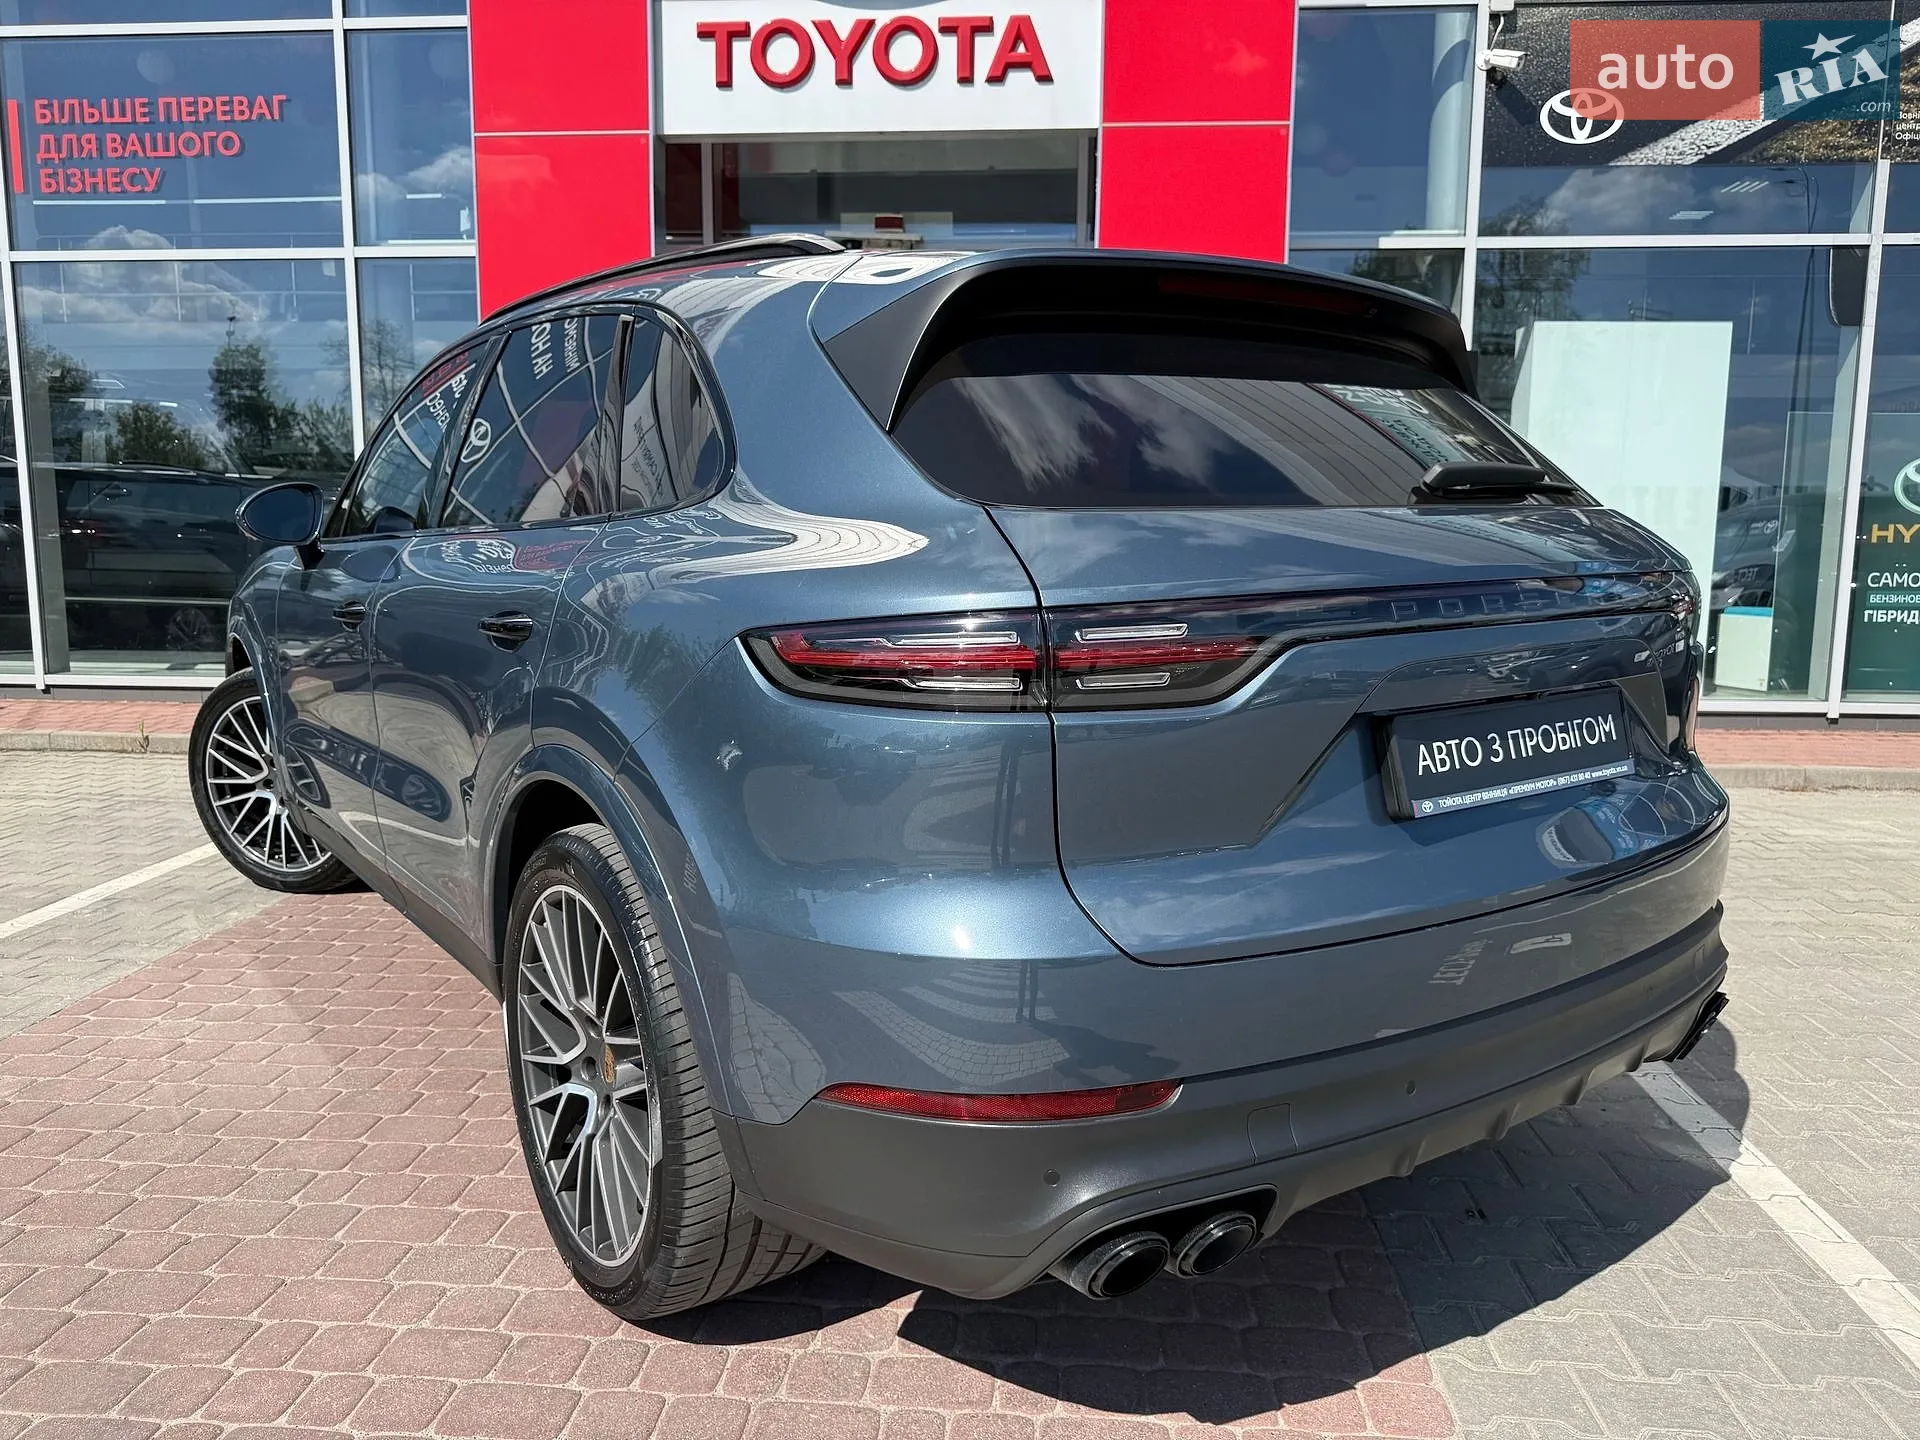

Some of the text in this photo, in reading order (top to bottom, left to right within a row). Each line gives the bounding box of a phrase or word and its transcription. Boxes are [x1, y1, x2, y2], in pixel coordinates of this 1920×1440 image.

[696, 14, 1054, 88] TOYOTA
[33, 94, 287, 125] БІЛЬШЕ ПЕРЕВАГ
[36, 130, 241, 164] ДЛЯ ВАШОГО
[39, 167, 161, 193] БІЗНЕСУ
[1417, 736, 1483, 776] АВТО
[1507, 713, 1617, 760] ПРОБІГОМ
